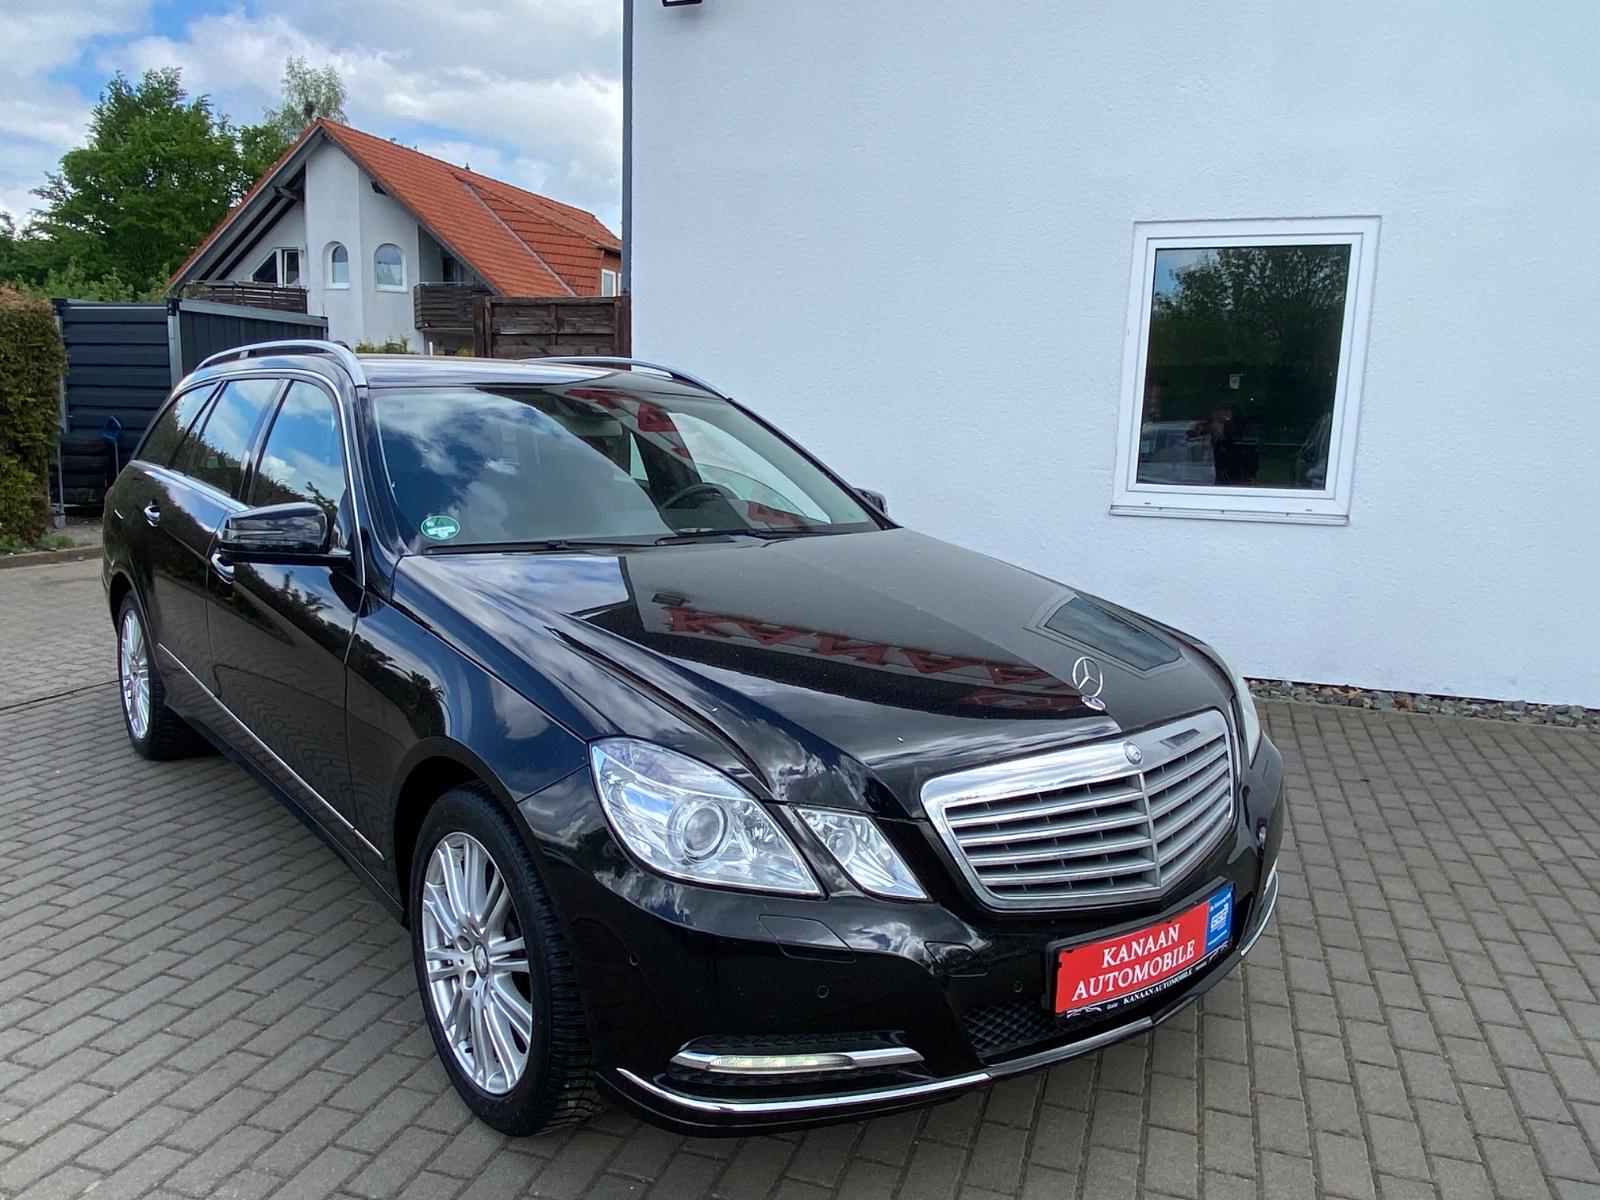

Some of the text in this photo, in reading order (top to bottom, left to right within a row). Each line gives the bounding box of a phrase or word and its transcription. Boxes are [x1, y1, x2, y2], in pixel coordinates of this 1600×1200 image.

[1102, 924, 1180, 968] KANAAN
[1072, 940, 1195, 1001] AUTOMOBILE
[1123, 969, 1193, 1004] KANAAN AUTOMOBILE
